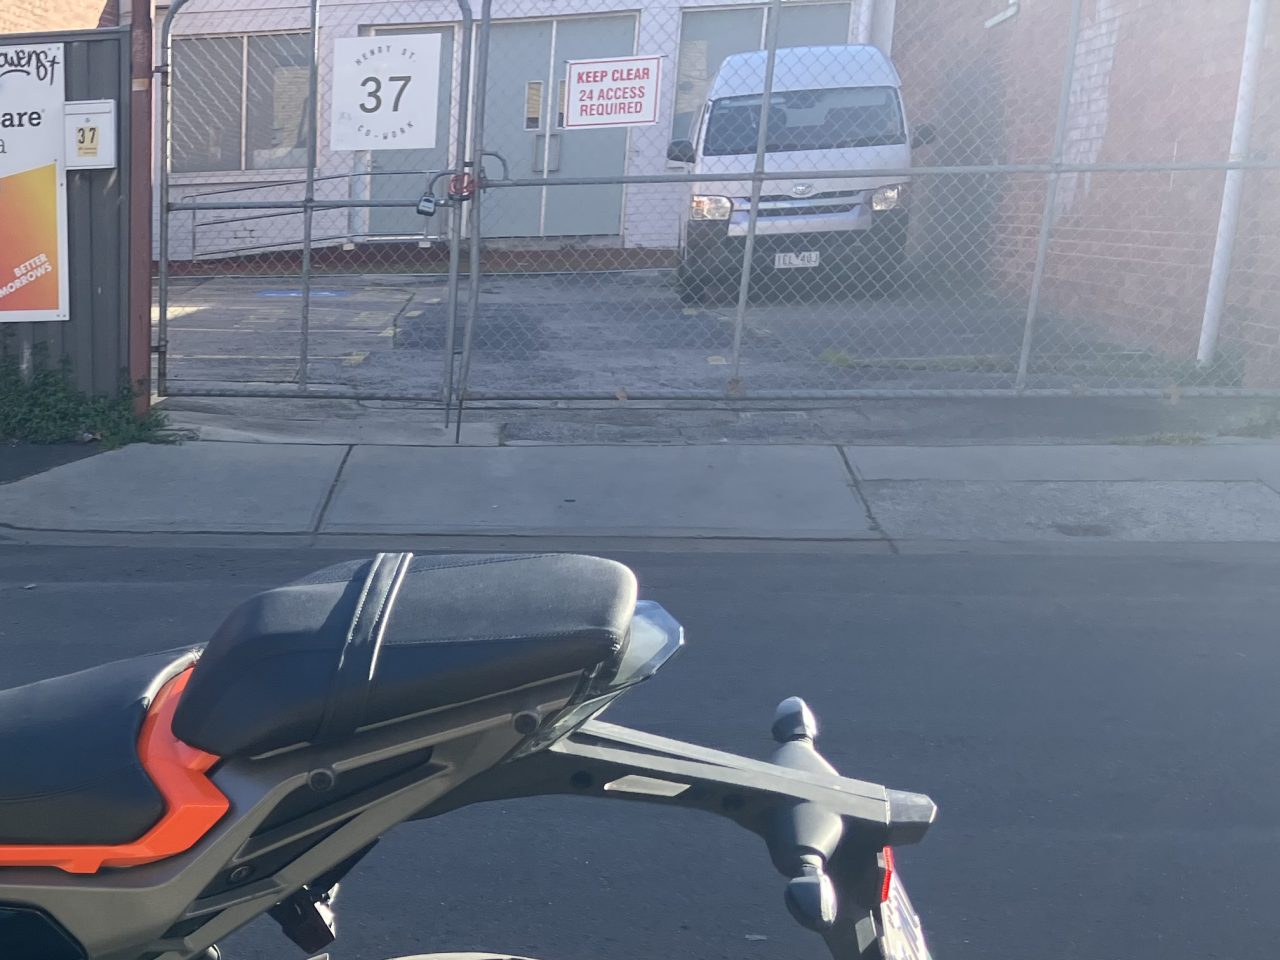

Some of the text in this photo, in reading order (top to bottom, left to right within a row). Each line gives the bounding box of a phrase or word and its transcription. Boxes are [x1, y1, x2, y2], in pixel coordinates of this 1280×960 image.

[577, 67, 650, 84] KEEP CLEAR
[359, 75, 412, 113] 37
[579, 86, 646, 102] 24 ACCESS
[580, 101, 643, 117] REQUIRED
[77, 127, 97, 144] 37
[13, 253, 48, 277] BETTER
